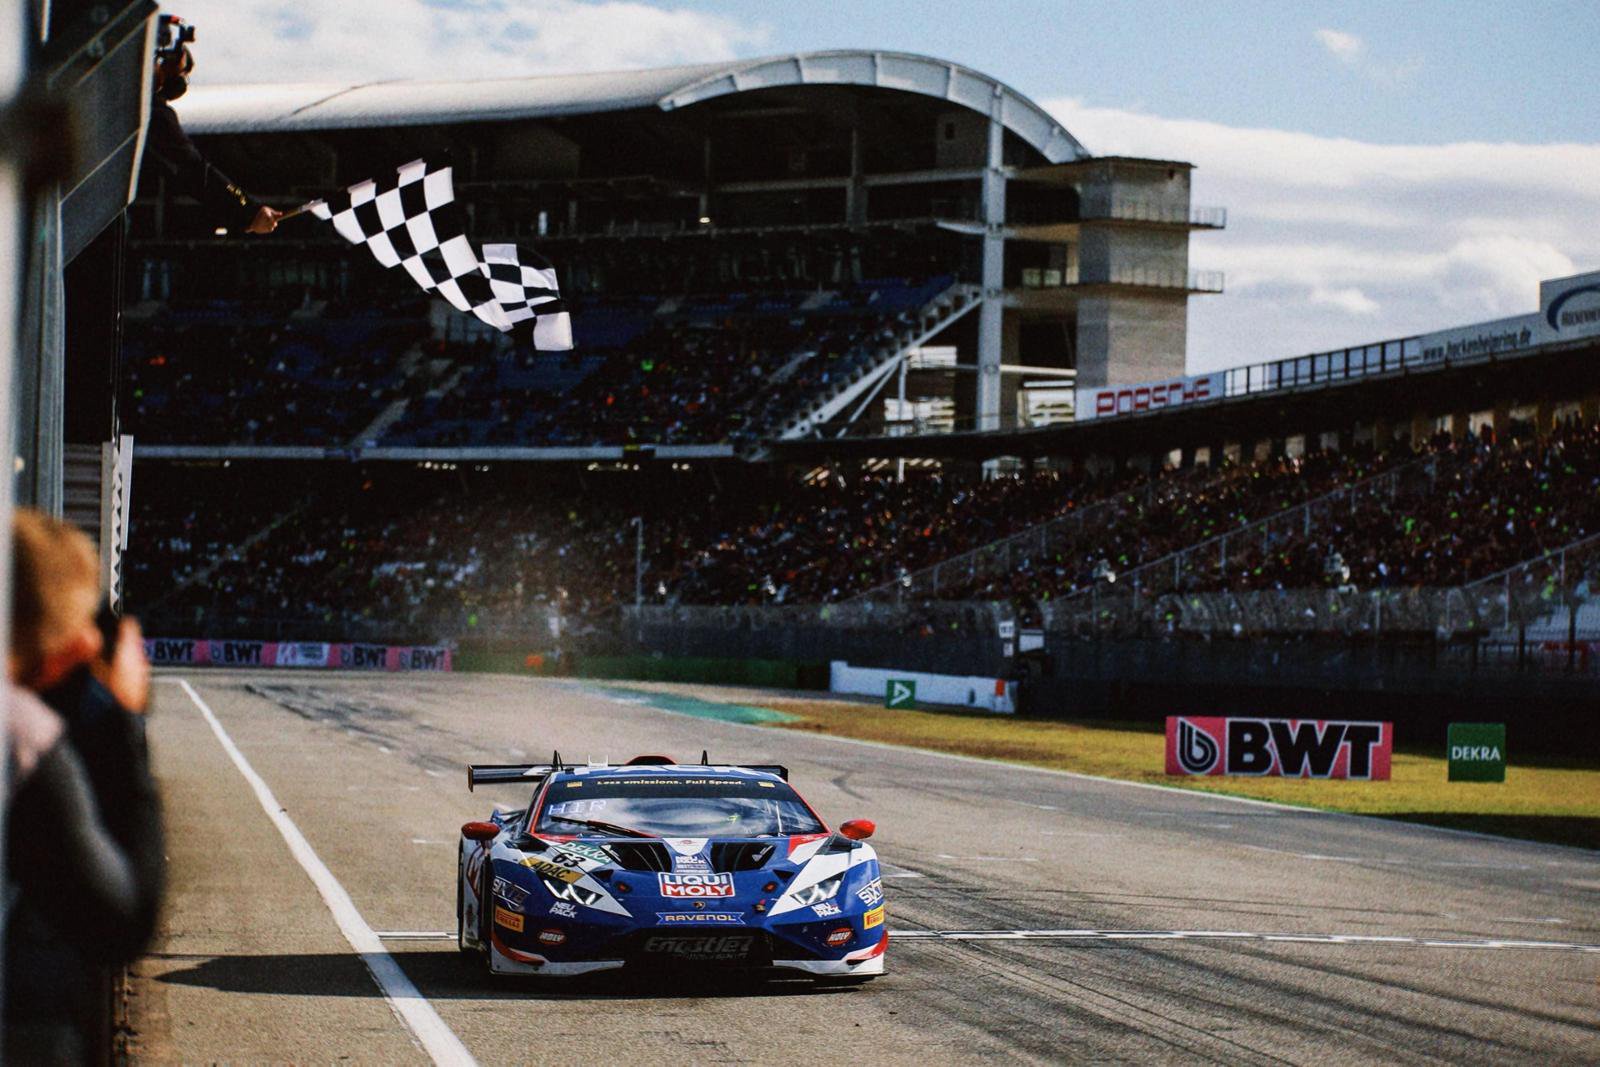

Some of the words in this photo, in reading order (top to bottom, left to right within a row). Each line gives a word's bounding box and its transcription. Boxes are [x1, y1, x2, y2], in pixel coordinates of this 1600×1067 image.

[1096, 378, 1210, 415] PORSCHE
[154, 640, 194, 660] BWT
[224, 640, 262, 663] BWT
[353, 646, 387, 666] BWT
[411, 649, 445, 669] BWT
[1225, 717, 1382, 780] BWT
[1452, 746, 1501, 760] DEKRA
[552, 853, 587, 867] 63
[561, 842, 612, 864] DEKRA
[530, 861, 571, 878] ADAC
[663, 874, 729, 886] LIQUI
[665, 884, 730, 896] MOLY
[548, 908, 579, 918] PACK
[552, 901, 577, 911] NEU
[664, 914, 737, 922] RAVENOL
